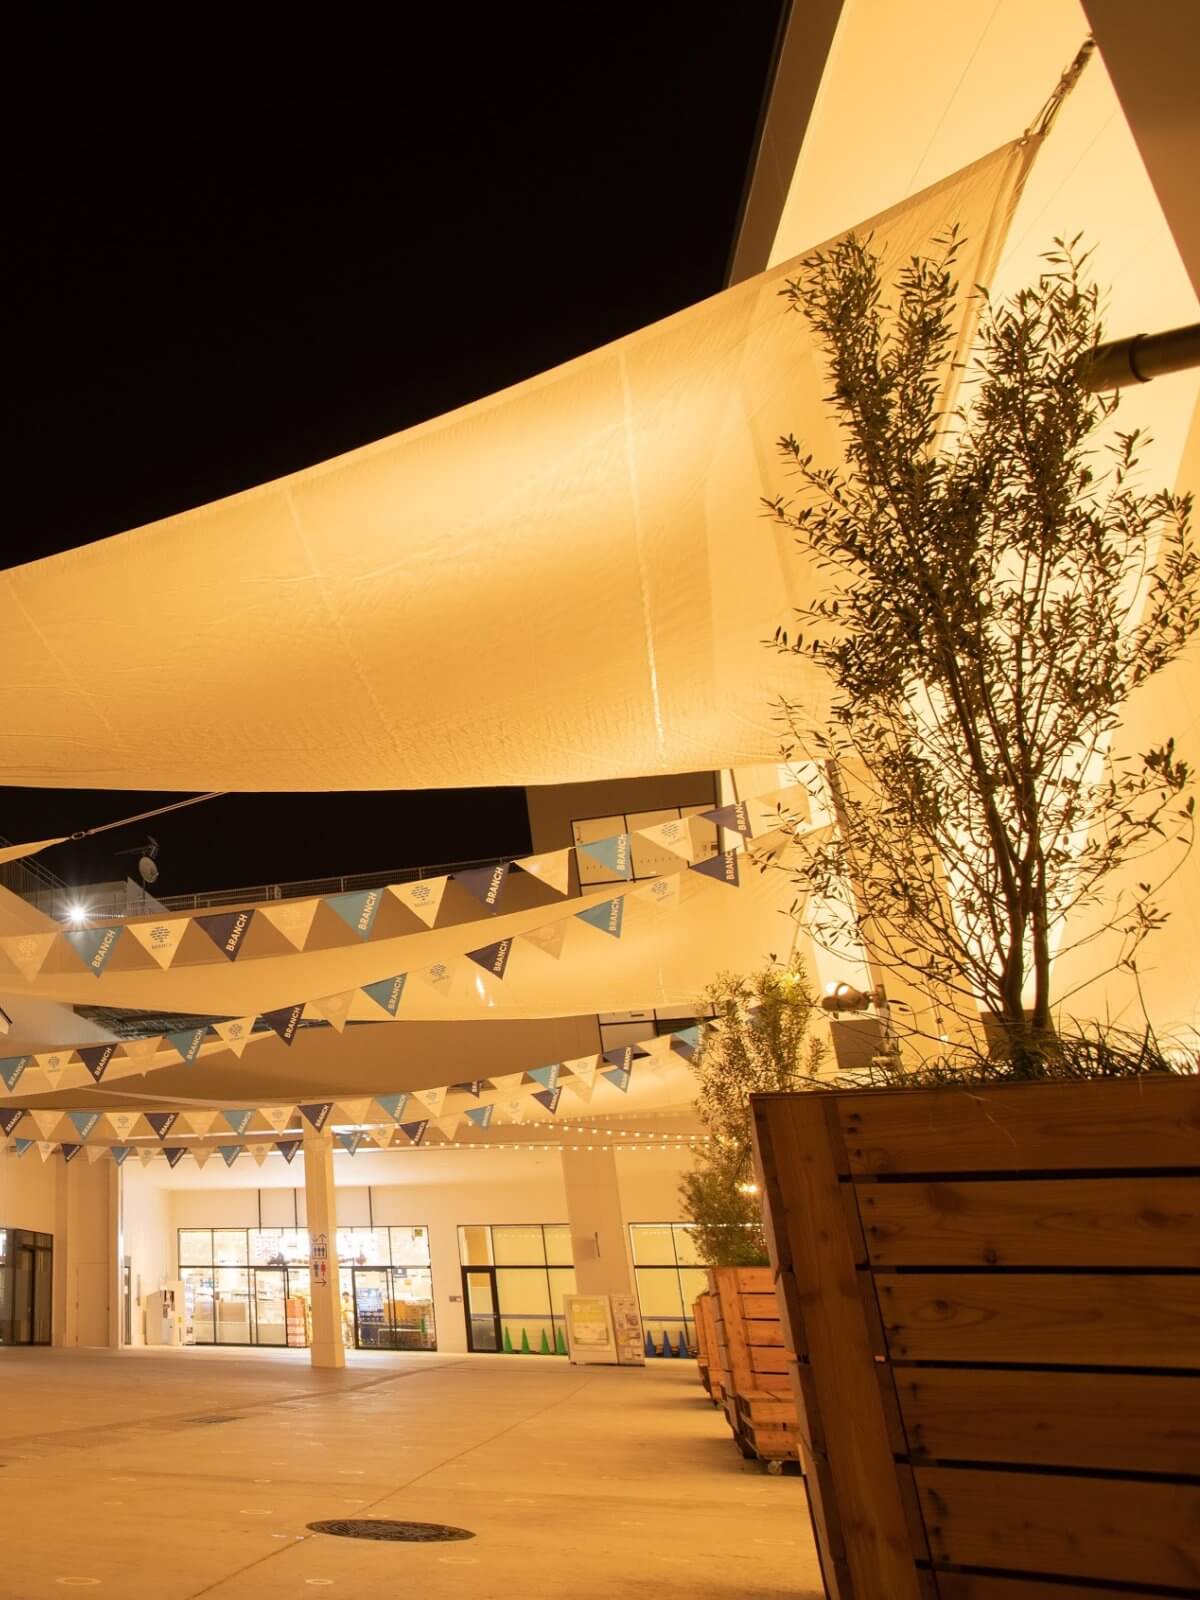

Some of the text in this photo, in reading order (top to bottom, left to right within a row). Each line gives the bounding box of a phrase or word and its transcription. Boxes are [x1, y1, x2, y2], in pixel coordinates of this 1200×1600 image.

[485, 866, 504, 904] BRANCH
[358, 892, 378, 930] BRANCH
[91, 929, 116, 968] BRANCH
[225, 913, 249, 952] BRANCH
[493, 941, 509, 973] BRANCH
[388, 977, 402, 1010] BRANCH
[284, 1007, 300, 1039] BRANCH
[187, 1029, 202, 1060] BRANCH
[94, 1047, 112, 1076] BRANCH
[5, 1111, 23, 1132] BRANCH
[81, 1114, 99, 1136] BRANCH
[159, 1114, 175, 1135] BRANCH
[315, 1104, 329, 1127] BRANCH
